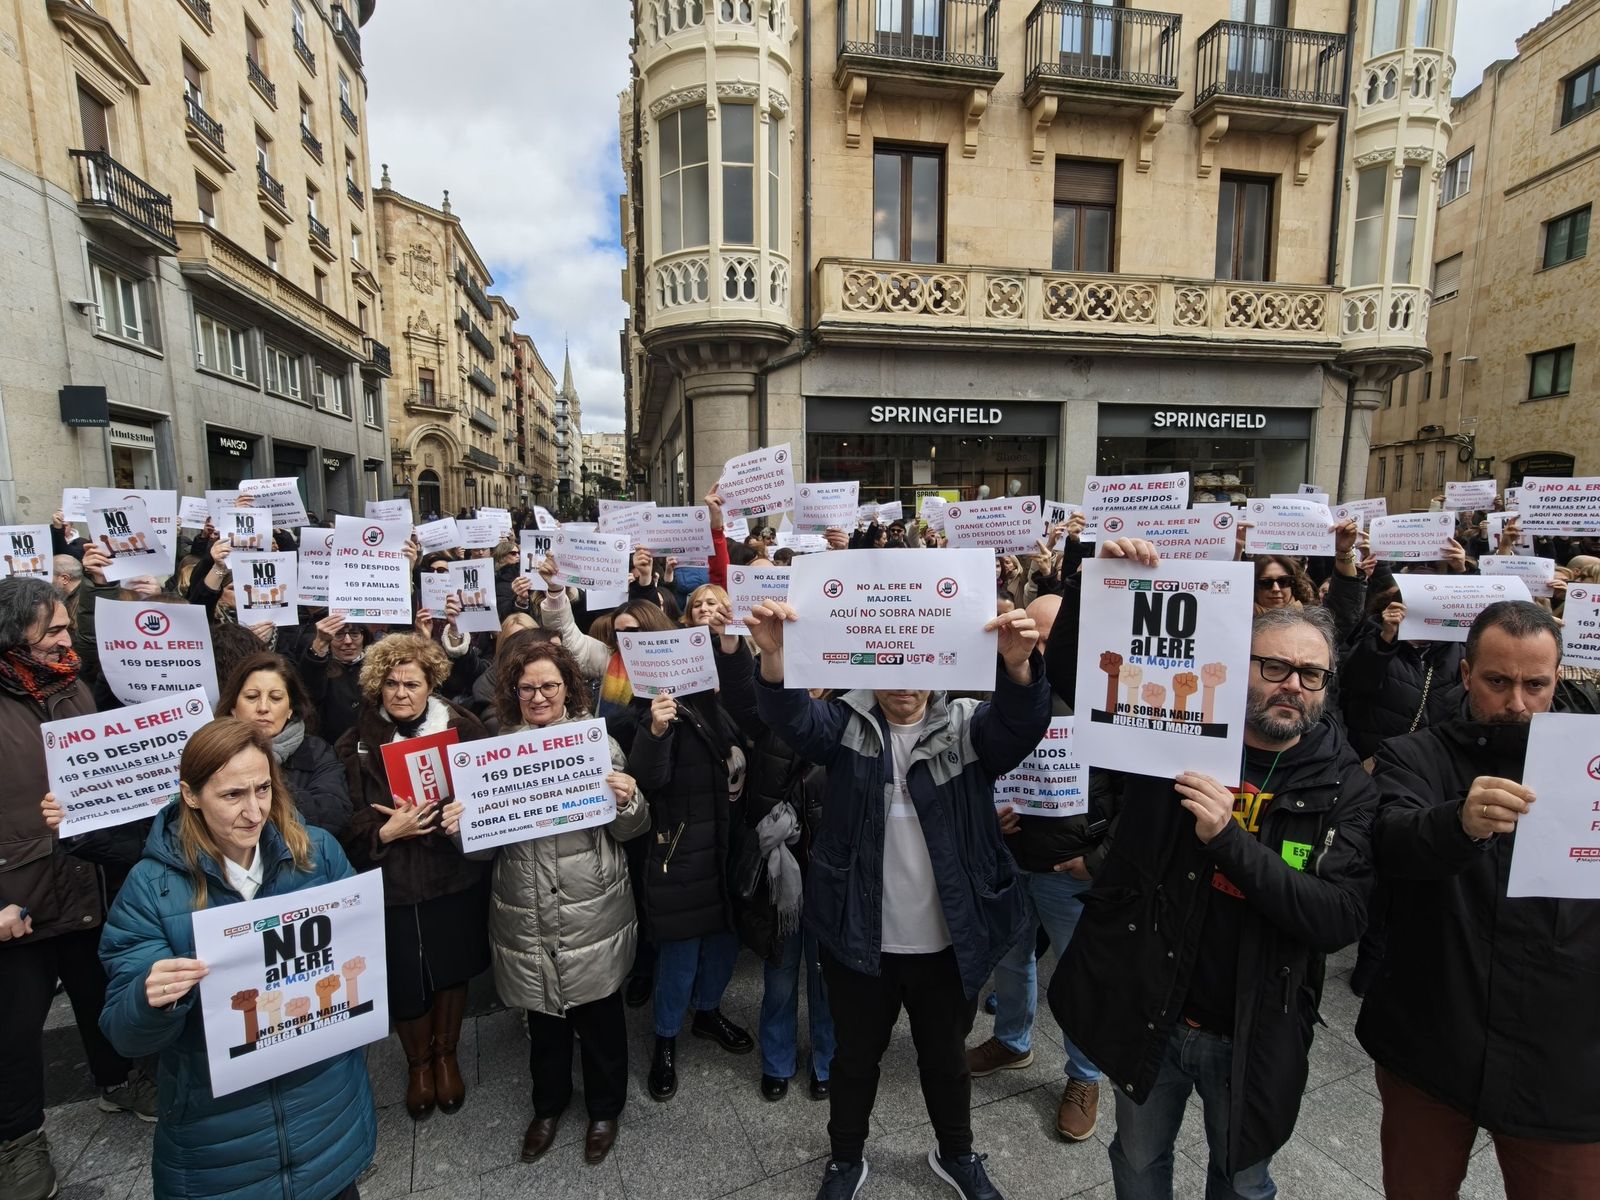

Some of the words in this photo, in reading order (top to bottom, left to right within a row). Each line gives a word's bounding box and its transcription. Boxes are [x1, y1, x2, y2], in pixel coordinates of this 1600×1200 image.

[871, 406, 1002, 424] SPRINGFIELD
[1154, 412, 1266, 428] SPRINGFIELD
[221, 438, 247, 450] MANGO
[721, 479, 748, 490] ORANGE
[749, 471, 774, 483] CÓMPLICE
[1102, 483, 1126, 492] ¡¡NO
[1148, 481, 1174, 490] ERE!!
[741, 494, 771, 505] PERSONAS
[104, 511, 129, 528] NO
[235, 516, 254, 527] NO
[986, 520, 1020, 528] CÓMPLICE
[11, 535, 34, 549] NO
[1156, 539, 1190, 547] SOBRA
[1195, 537, 1225, 545] NADIE
[337, 548, 359, 556] ¡¡NO
[362, 549, 375, 557] AL
[378, 551, 404, 559] ERE!!
[252, 563, 276, 578] NO
[344, 562, 358, 570] 169
[463, 569, 478, 582] NO
[830, 607, 857, 618] AQUÍ
[861, 609, 876, 617] NO
[879, 609, 915, 617] SOBRA
[919, 608, 951, 617] NADIE
[1132, 592, 1198, 638] NO
[846, 626, 882, 634] SOBRA
[885, 626, 896, 634] EL
[899, 626, 918, 634] ERE
[921, 626, 934, 634] DE
[105, 640, 137, 651] ¡¡NO
[144, 641, 160, 650] AL
[168, 641, 203, 650] ERE!!
[866, 641, 914, 649] MAJOREL
[121, 659, 141, 667] 169
[145, 659, 201, 667] DESPIDOS
[1129, 656, 1142, 664] en
[1146, 657, 1194, 669] Majorel
[128, 683, 148, 691] 169
[151, 683, 202, 691] FAMILIAS
[59, 728, 96, 749] ¡¡NO
[104, 722, 131, 736] AL
[134, 708, 183, 729] ERE!!
[1113, 715, 1149, 728] HUELGA
[1152, 720, 1162, 729] 10
[1165, 723, 1201, 735] MARZO
[66, 752, 99, 766] 169
[104, 730, 188, 758] DESPIDOS
[476, 748, 511, 767] ¡¡NO
[517, 743, 538, 756] AL
[543, 734, 583, 751] ERE!!
[59, 774, 78, 784] 169
[82, 759, 142, 778] FAMILIAS
[144, 753, 159, 764] EN
[416, 754, 436, 799] UGT
[482, 770, 508, 783] 169
[513, 755, 585, 777] DESPIDOS
[71, 781, 113, 798] ¡¡AQUÍ
[116, 776, 133, 786] NO
[136, 767, 171, 781] SOBRA
[471, 790, 489, 799] 169
[493, 780, 538, 795] FAMILIAS
[542, 776, 554, 785] EN
[558, 774, 570, 782] LA
[572, 767, 602, 778] CALLE
[66, 796, 116, 811] SOBRA
[118, 790, 132, 800] EL
[135, 785, 155, 796] ERE
[157, 781, 171, 790] DE
[478, 800, 509, 814] ¡¡AQUÍ
[513, 796, 527, 805] NO
[529, 789, 563, 801] SOBRA
[566, 782, 600, 794] NADIE!!
[471, 816, 505, 828] SOBRA
[509, 812, 521, 820] EL
[524, 808, 543, 817] ERE
[546, 805, 559, 813] DE
[562, 795, 607, 809] MAJOREL
[263, 915, 332, 967] NO
[266, 963, 288, 983] al
[294, 948, 332, 975] ERE
[266, 981, 281, 991] en
[285, 964, 335, 985] Majorel
[256, 1028, 298, 1049] HUELGA
[300, 1024, 313, 1035] 10
[315, 1012, 350, 1030] MARZO
